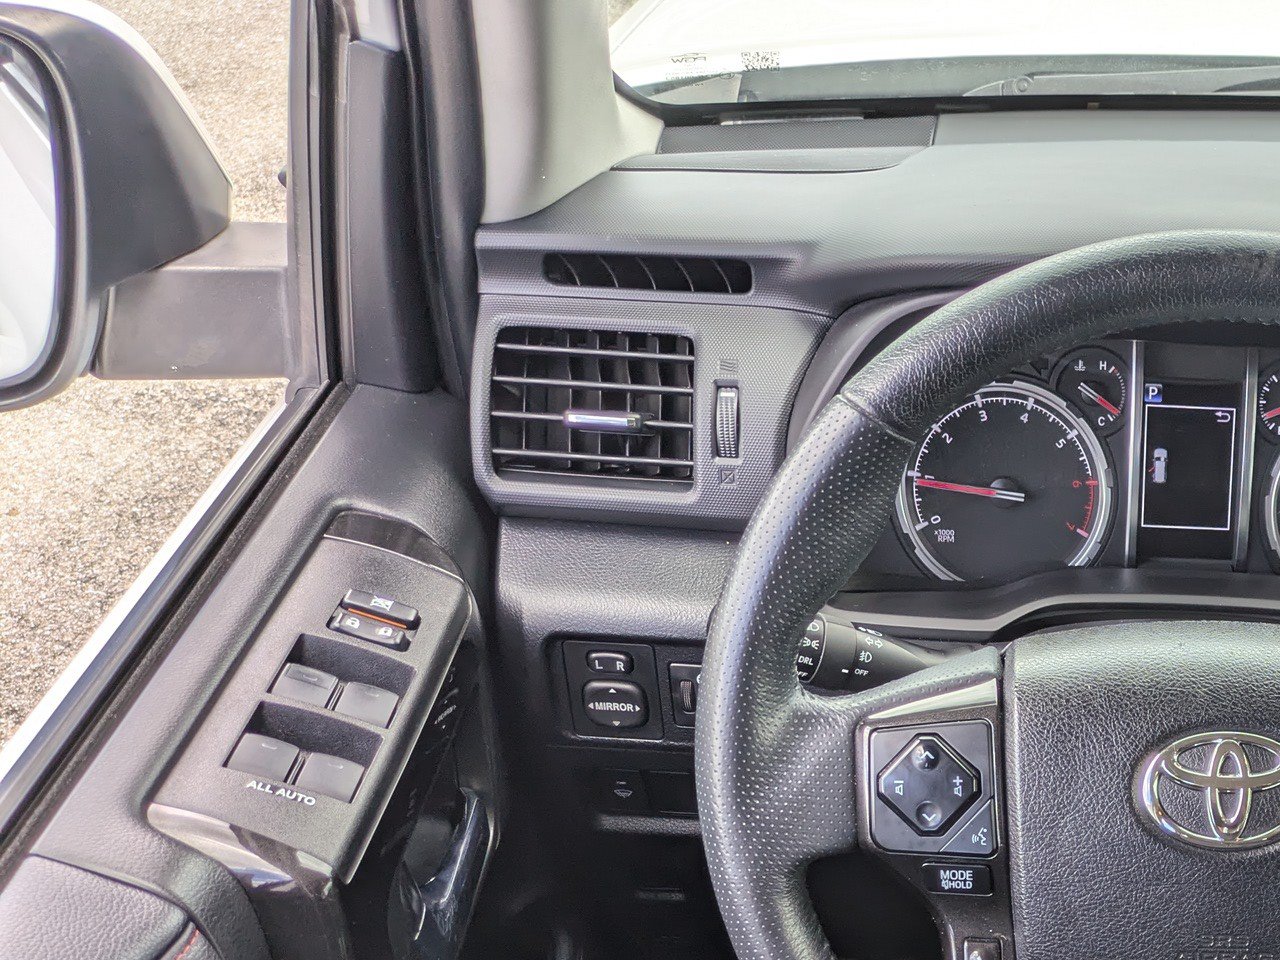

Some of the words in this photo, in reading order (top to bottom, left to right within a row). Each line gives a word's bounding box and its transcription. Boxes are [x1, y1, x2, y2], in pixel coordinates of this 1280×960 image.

[1099, 360, 1107, 371] H
[1149, 387, 1159, 400] P
[979, 411, 988, 422] 3
[1020, 413, 1030, 424] 4
[1097, 416, 1106, 427] C
[941, 431, 954, 445] 2
[1055, 438, 1067, 449] 5
[930, 515, 942, 525] 0
[594, 659, 604, 670] L
[798, 655, 814, 666] DRL
[616, 661, 625, 672] R
[854, 668, 869, 676] OFF
[594, 701, 634, 712] MIRROR
[246, 780, 274, 794] ALL
[275, 788, 316, 806] AUTO
[940, 869, 974, 881] MODE
[949, 880, 973, 889] HOLD
